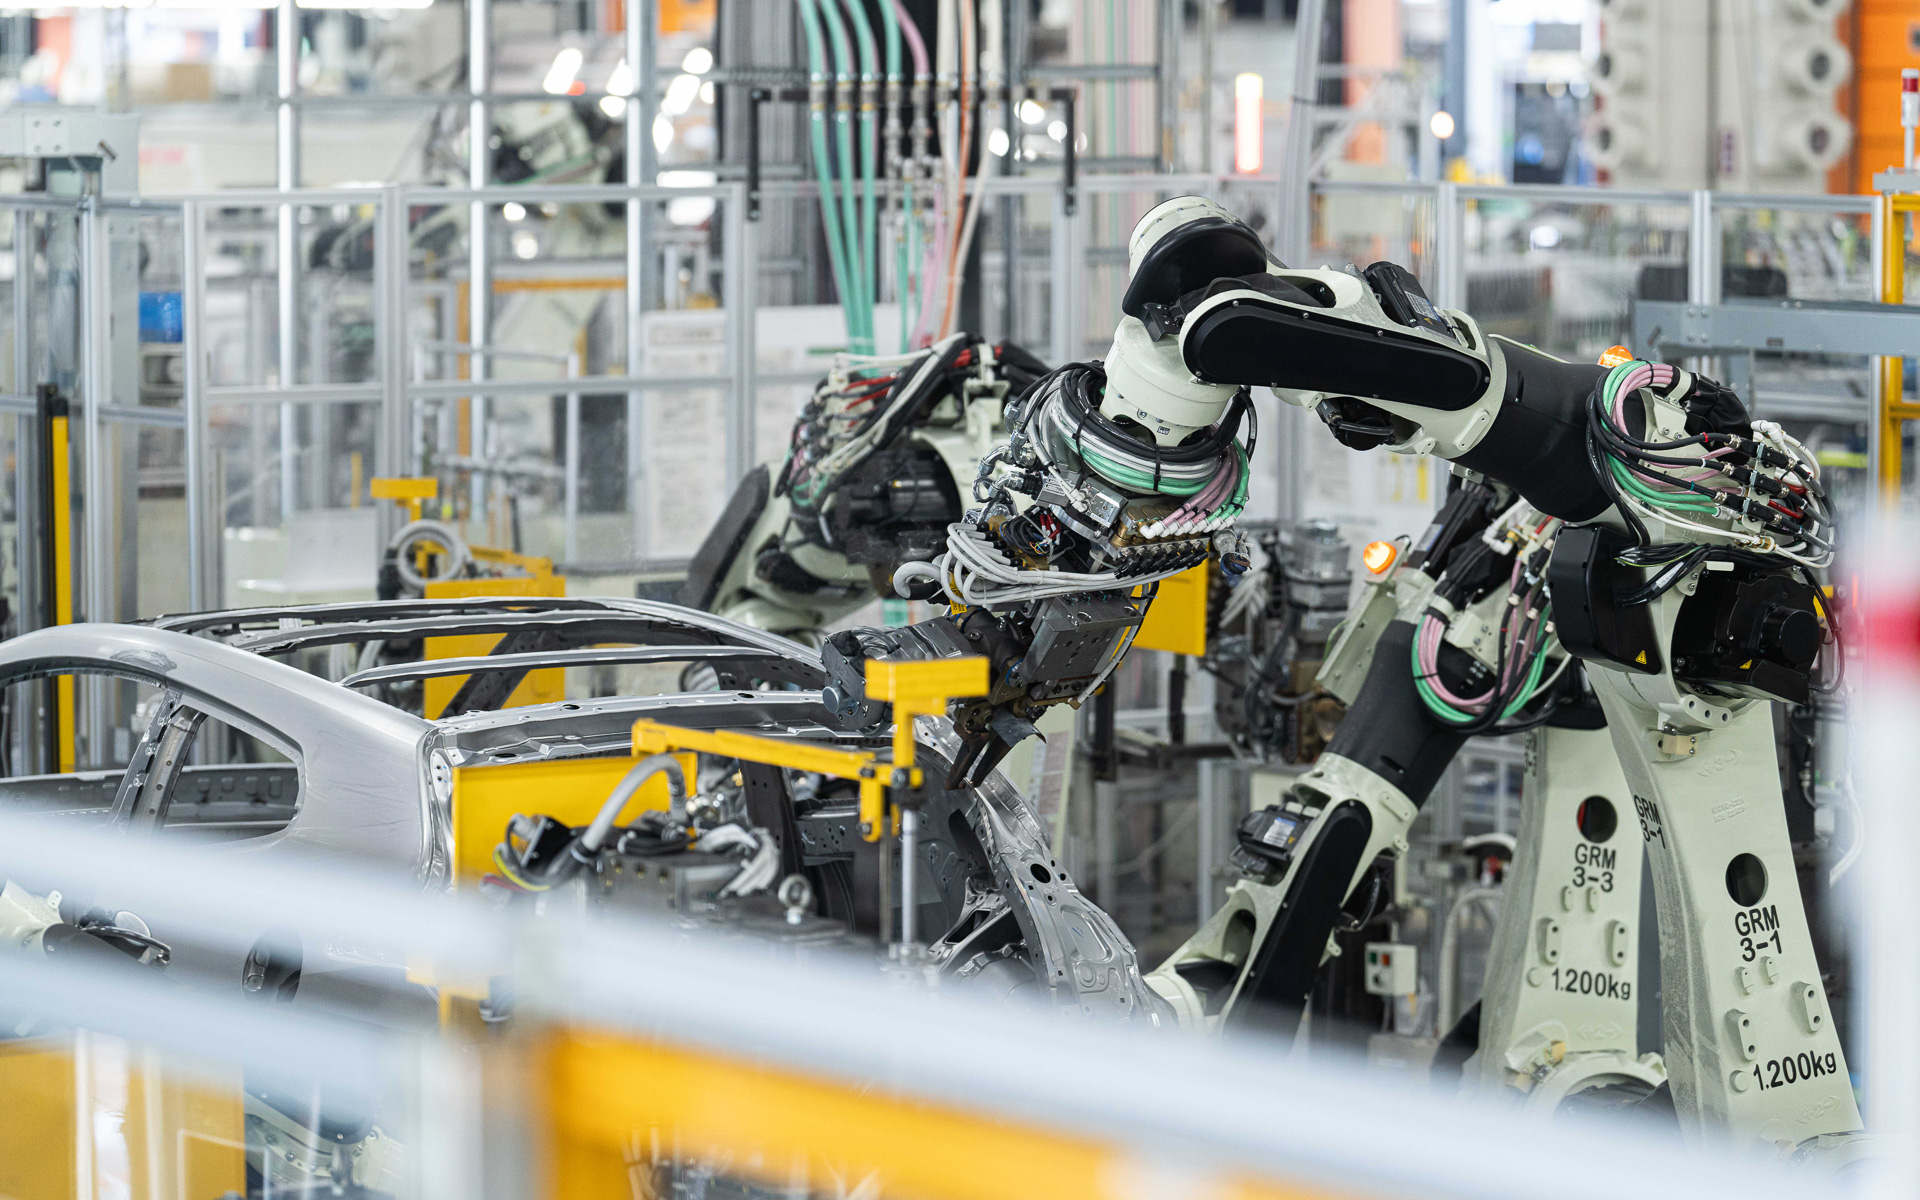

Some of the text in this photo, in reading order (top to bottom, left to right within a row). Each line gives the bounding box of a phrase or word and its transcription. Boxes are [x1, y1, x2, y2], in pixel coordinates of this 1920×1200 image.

[1633, 794, 1662, 826] GRM
[1640, 819, 1666, 850] 3-1
[1574, 843, 1617, 870] GRM
[1572, 866, 1614, 893] 3-3
[1734, 904, 1780, 937] GRM
[1740, 929, 1782, 962] 3-1
[1552, 967, 1631, 1001] 1.200kg
[1752, 1050, 1837, 1091] 1.200kg
